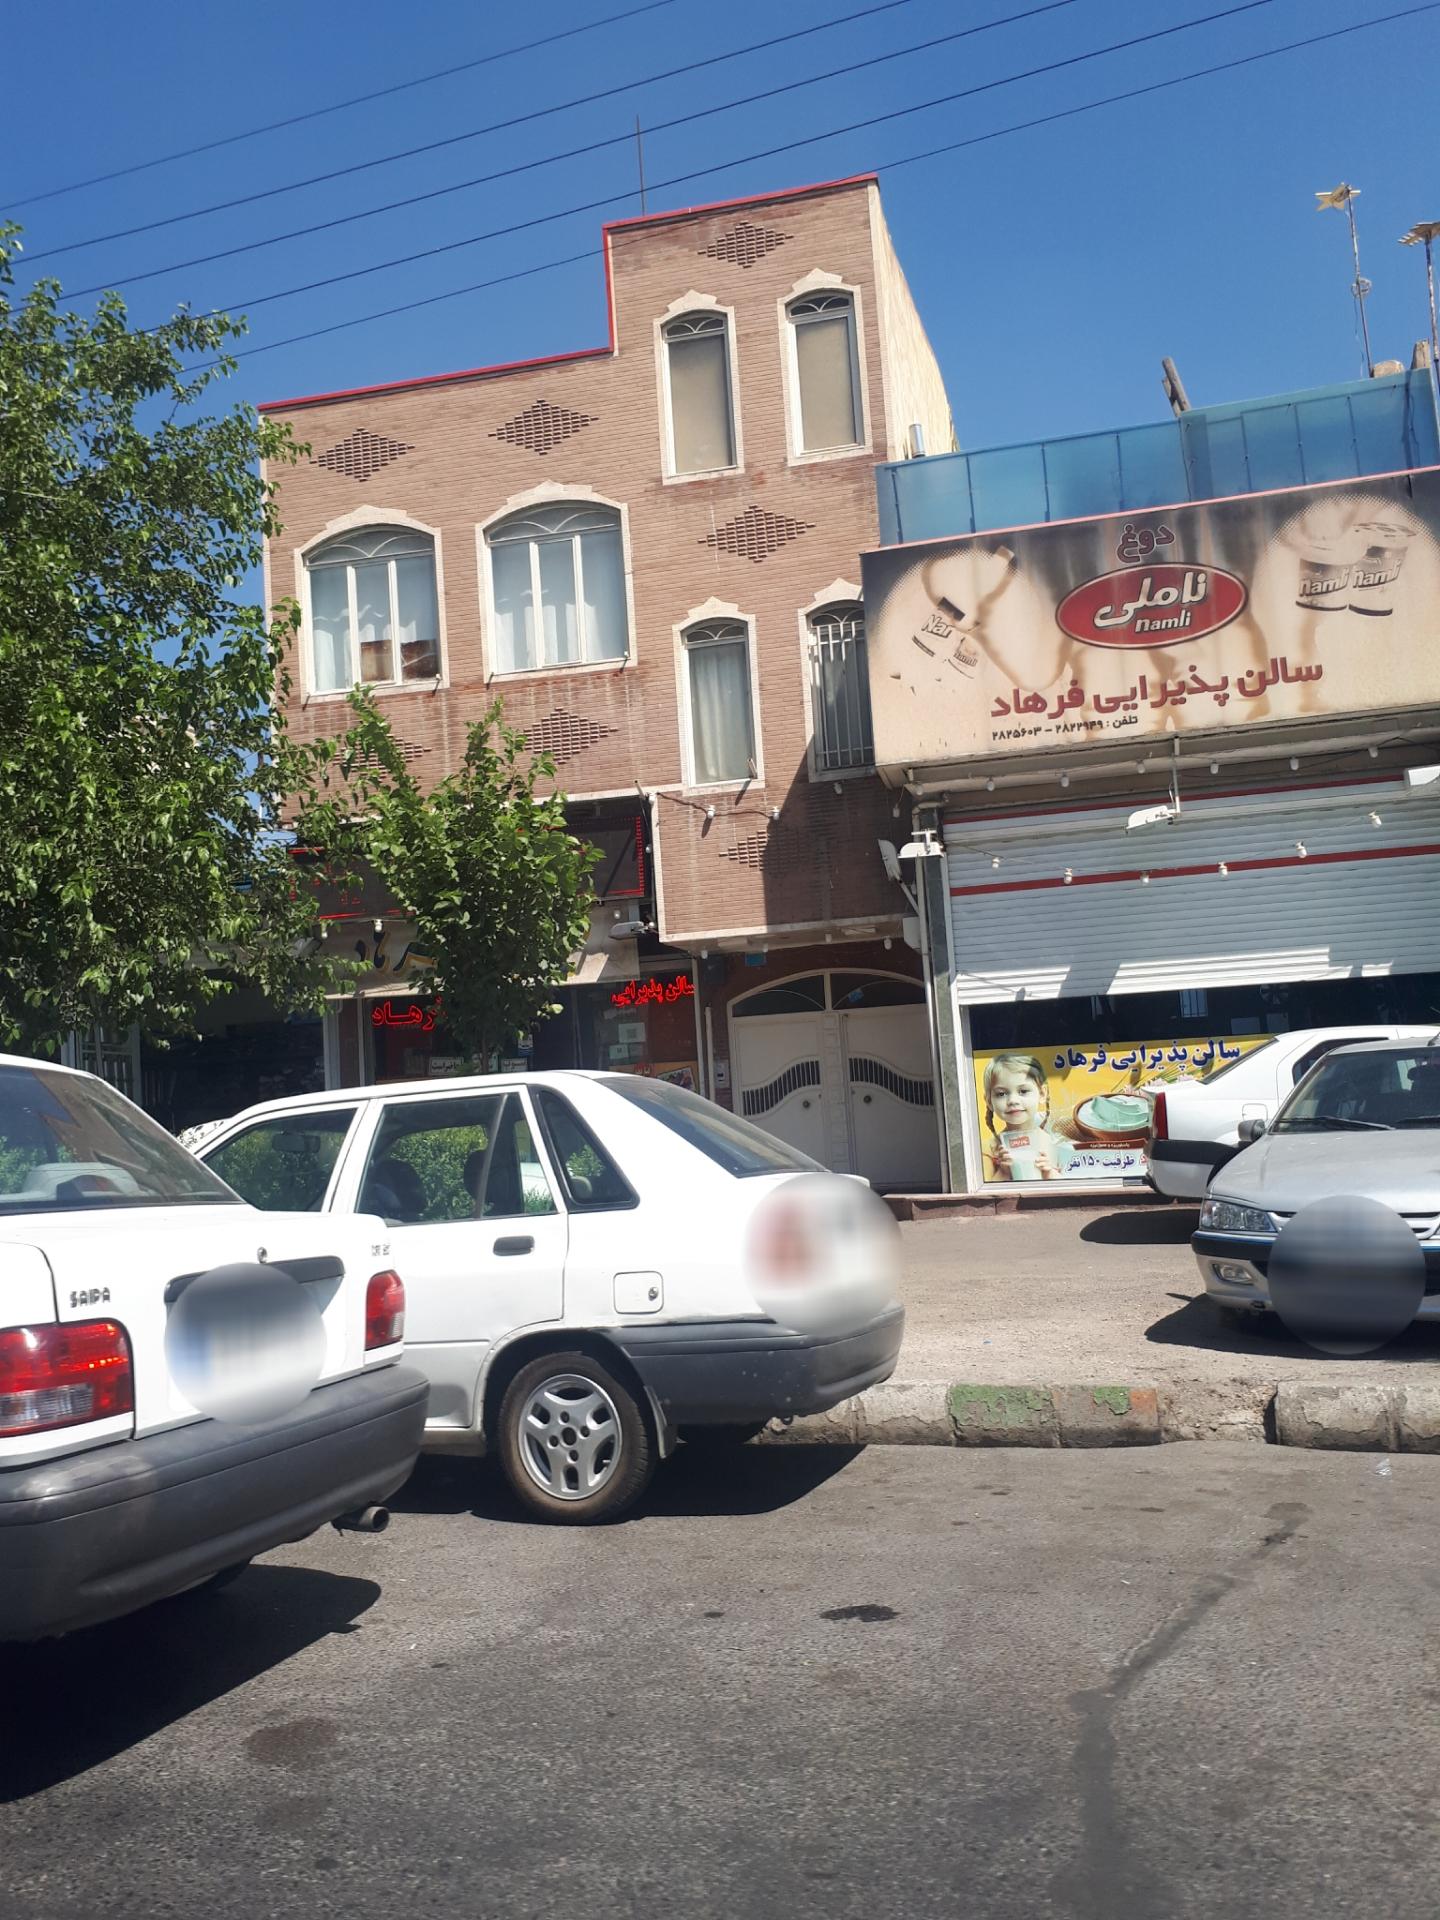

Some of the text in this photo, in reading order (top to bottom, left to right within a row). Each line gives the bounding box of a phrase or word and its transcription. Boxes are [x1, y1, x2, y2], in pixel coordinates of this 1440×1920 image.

[1117, 524, 1176, 563] دوغ
[1094, 572, 1207, 627] ناملی
[1135, 610, 1191, 633] namli
[991, 656, 1323, 719] سالن پذیرایی فرهاد
[992, 726, 1042, 742] ۲۸۲۵۶۰۳
[666, 975, 696, 1002] سالن
[1054, 1039, 1241, 1072] سالن پذیرایی فرهاد
[1067, 1155, 1081, 1171] نفر
[1083, 1155, 1100, 1167] ۱۵۰
[1103, 1153, 1135, 1169] ظرفیت
